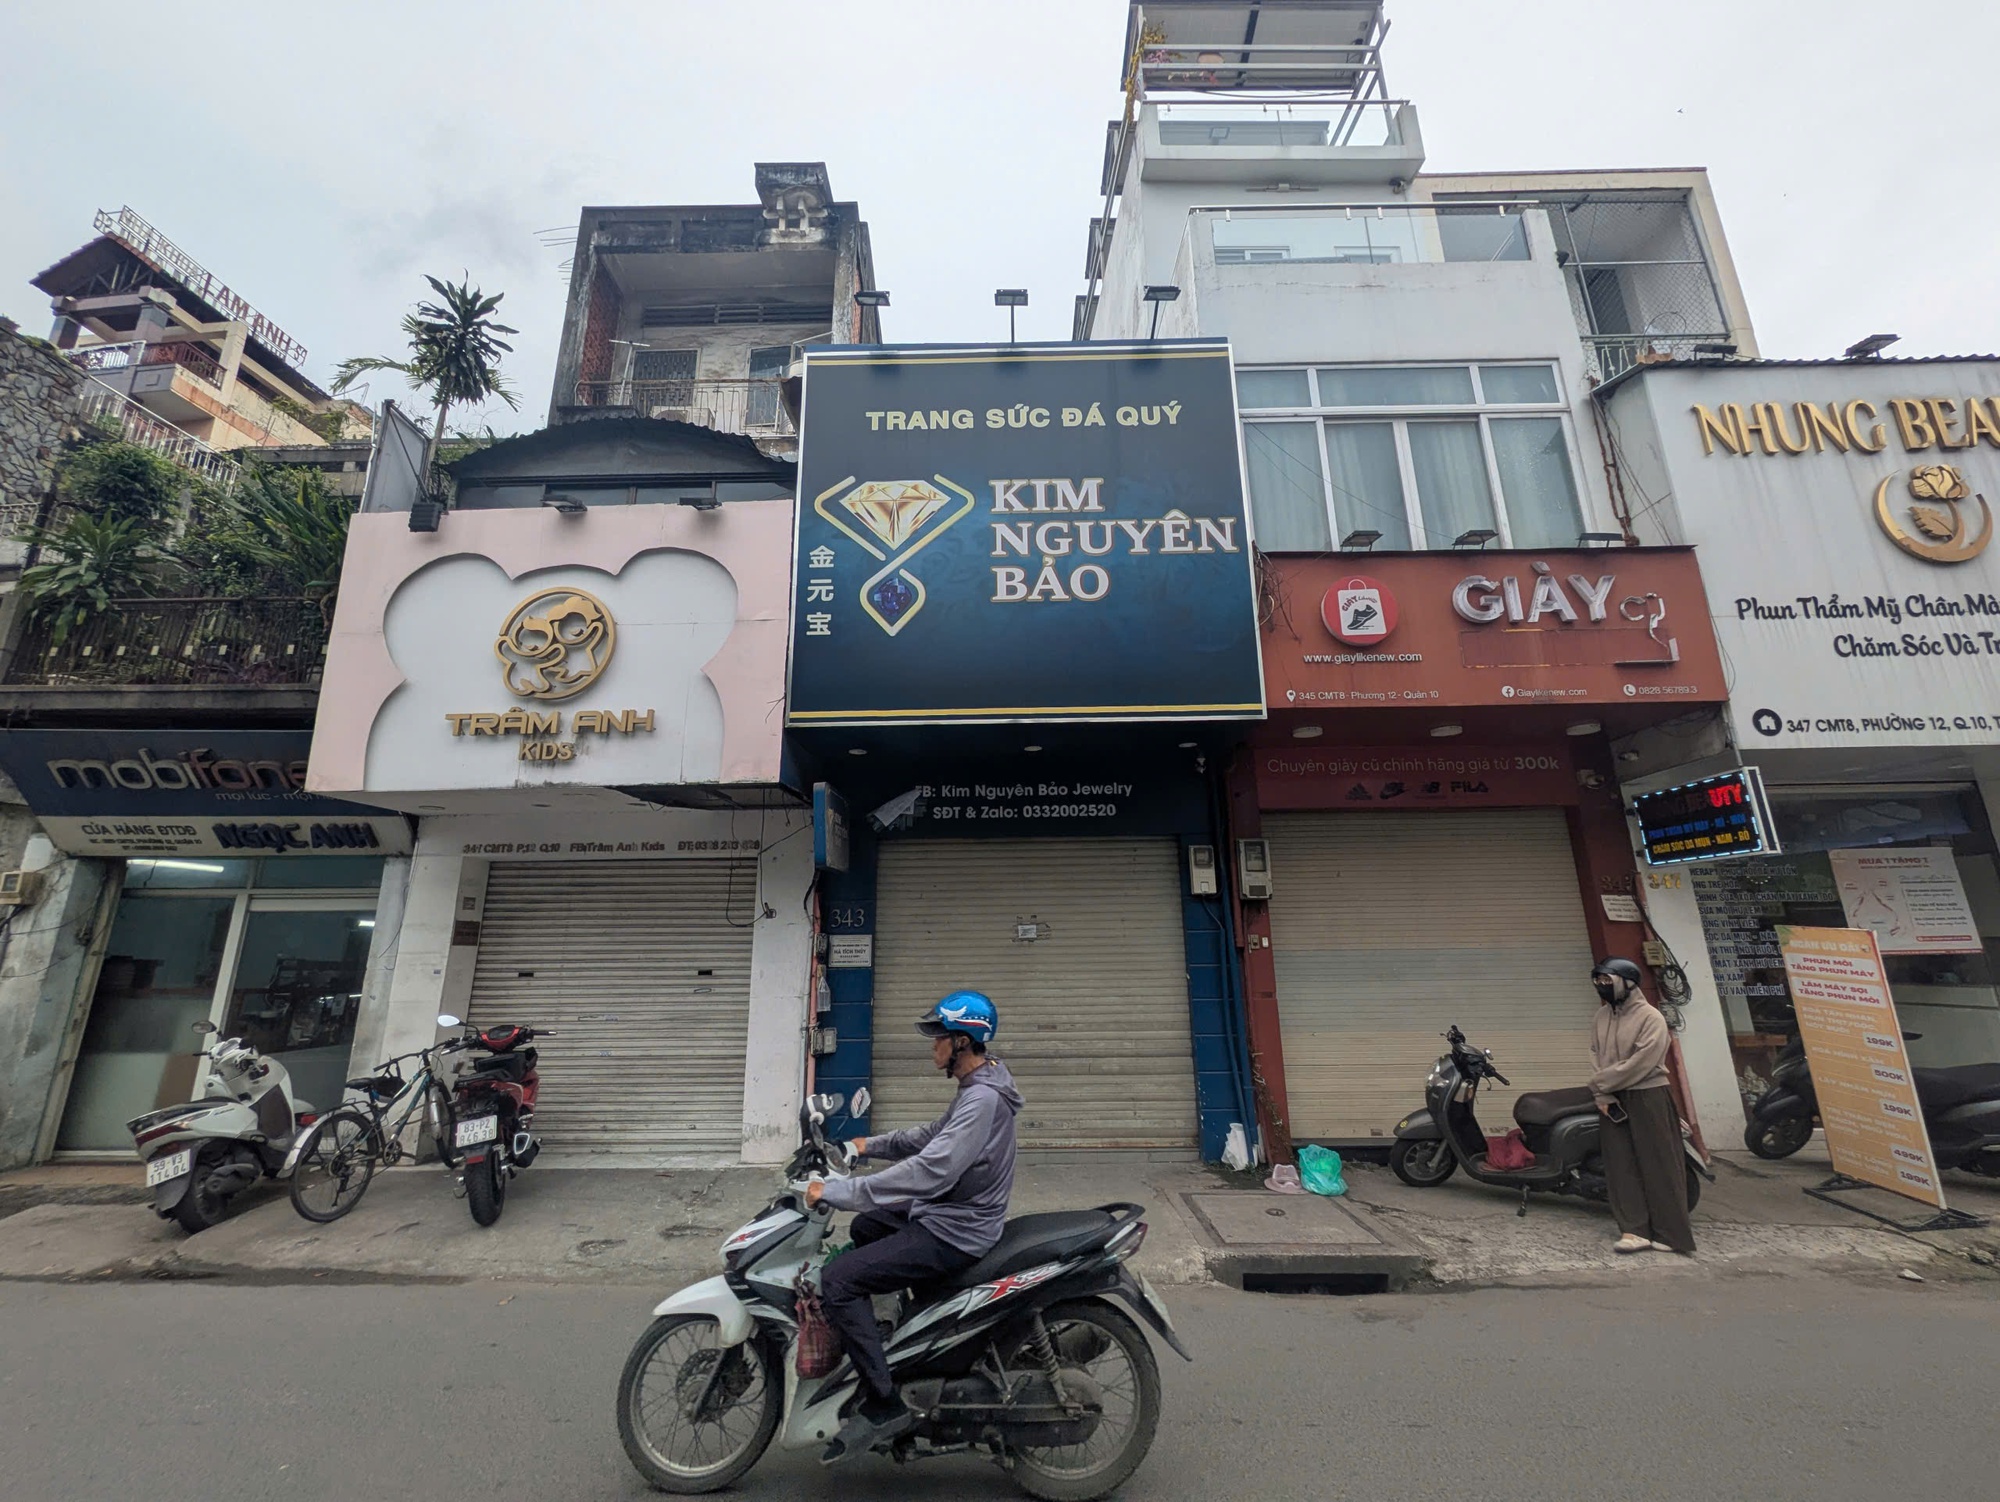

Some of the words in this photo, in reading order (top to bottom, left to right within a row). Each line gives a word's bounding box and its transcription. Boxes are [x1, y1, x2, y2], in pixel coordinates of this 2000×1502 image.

[866, 409, 974, 430] TRANG
[986, 403, 1050, 428] SỨC
[1062, 402, 1105, 427] ĐÁ
[1116, 400, 1182, 426] QUÝ
[1691, 399, 1887, 456] NHUNG
[989, 477, 1105, 513] KIM
[990, 508, 1239, 557] NGUYÊN
[990, 556, 1111, 602] BẢO
[806, 545, 835, 635] 金元宝
[1452, 561, 1617, 624] GIÀY
[1735, 597, 1797, 620] Phun
[1796, 594, 1863, 620] Thẩm
[1864, 596, 1902, 624] Mỹ
[1906, 594, 1964, 617] Chân
[1834, 634, 1900, 657] Chăm
[1901, 634, 1944, 656] Sóc
[1943, 632, 1980, 656] Và
[1299, 692, 1316, 700] 345
[1430, 690, 1439, 699] 10
[445, 706, 561, 736] TRÂM
[572, 709, 655, 734] ANH
[1787, 720, 1810, 732] 347
[1816, 719, 1859, 734] CMT8,
[1862, 713, 1925, 732] PHƯỜNG
[1929, 717, 1951, 732] 12,
[519, 742, 576, 761] KIDS
[48, 748, 306, 789] mobifone
[1268, 759, 1324, 775] Chuyên
[1329, 760, 1357, 774] giày
[1362, 759, 1379, 772] cũ
[1383, 758, 1424, 772] chính
[1428, 758, 1464, 774] hãng
[1469, 756, 1490, 772] giá
[1493, 756, 1510, 770] từ
[1514, 756, 1560, 770] 300k
[942, 785, 970, 798] Kim
[975, 784, 1034, 800] Nguyên
[1038, 782, 1068, 796] Bảo
[1072, 782, 1132, 797] Jewelry
[933, 806, 960, 819] SĐT
[966, 806, 976, 818] &
[981, 806, 1018, 818] Zalo:
[1023, 804, 1116, 818] 0332002520
[81, 822, 112, 835] CỬA
[114, 822, 154, 836] HÀNG
[156, 825, 197, 836] ĐTDĐ
[212, 822, 309, 853] NGỌC
[310, 822, 380, 850] ANH
[831, 908, 864, 928] 343
[1802, 957, 1830, 965] PHUN
[1818, 966, 1848, 975] PHUN
[1826, 992, 1856, 1001] PHUN
[1866, 1036, 1894, 1048] 199K
[1874, 1070, 1904, 1082] 500K
[1883, 1103, 1912, 1117] 199K
[1894, 1148, 1924, 1164] 499K
[1900, 1170, 1930, 1187] 199K
